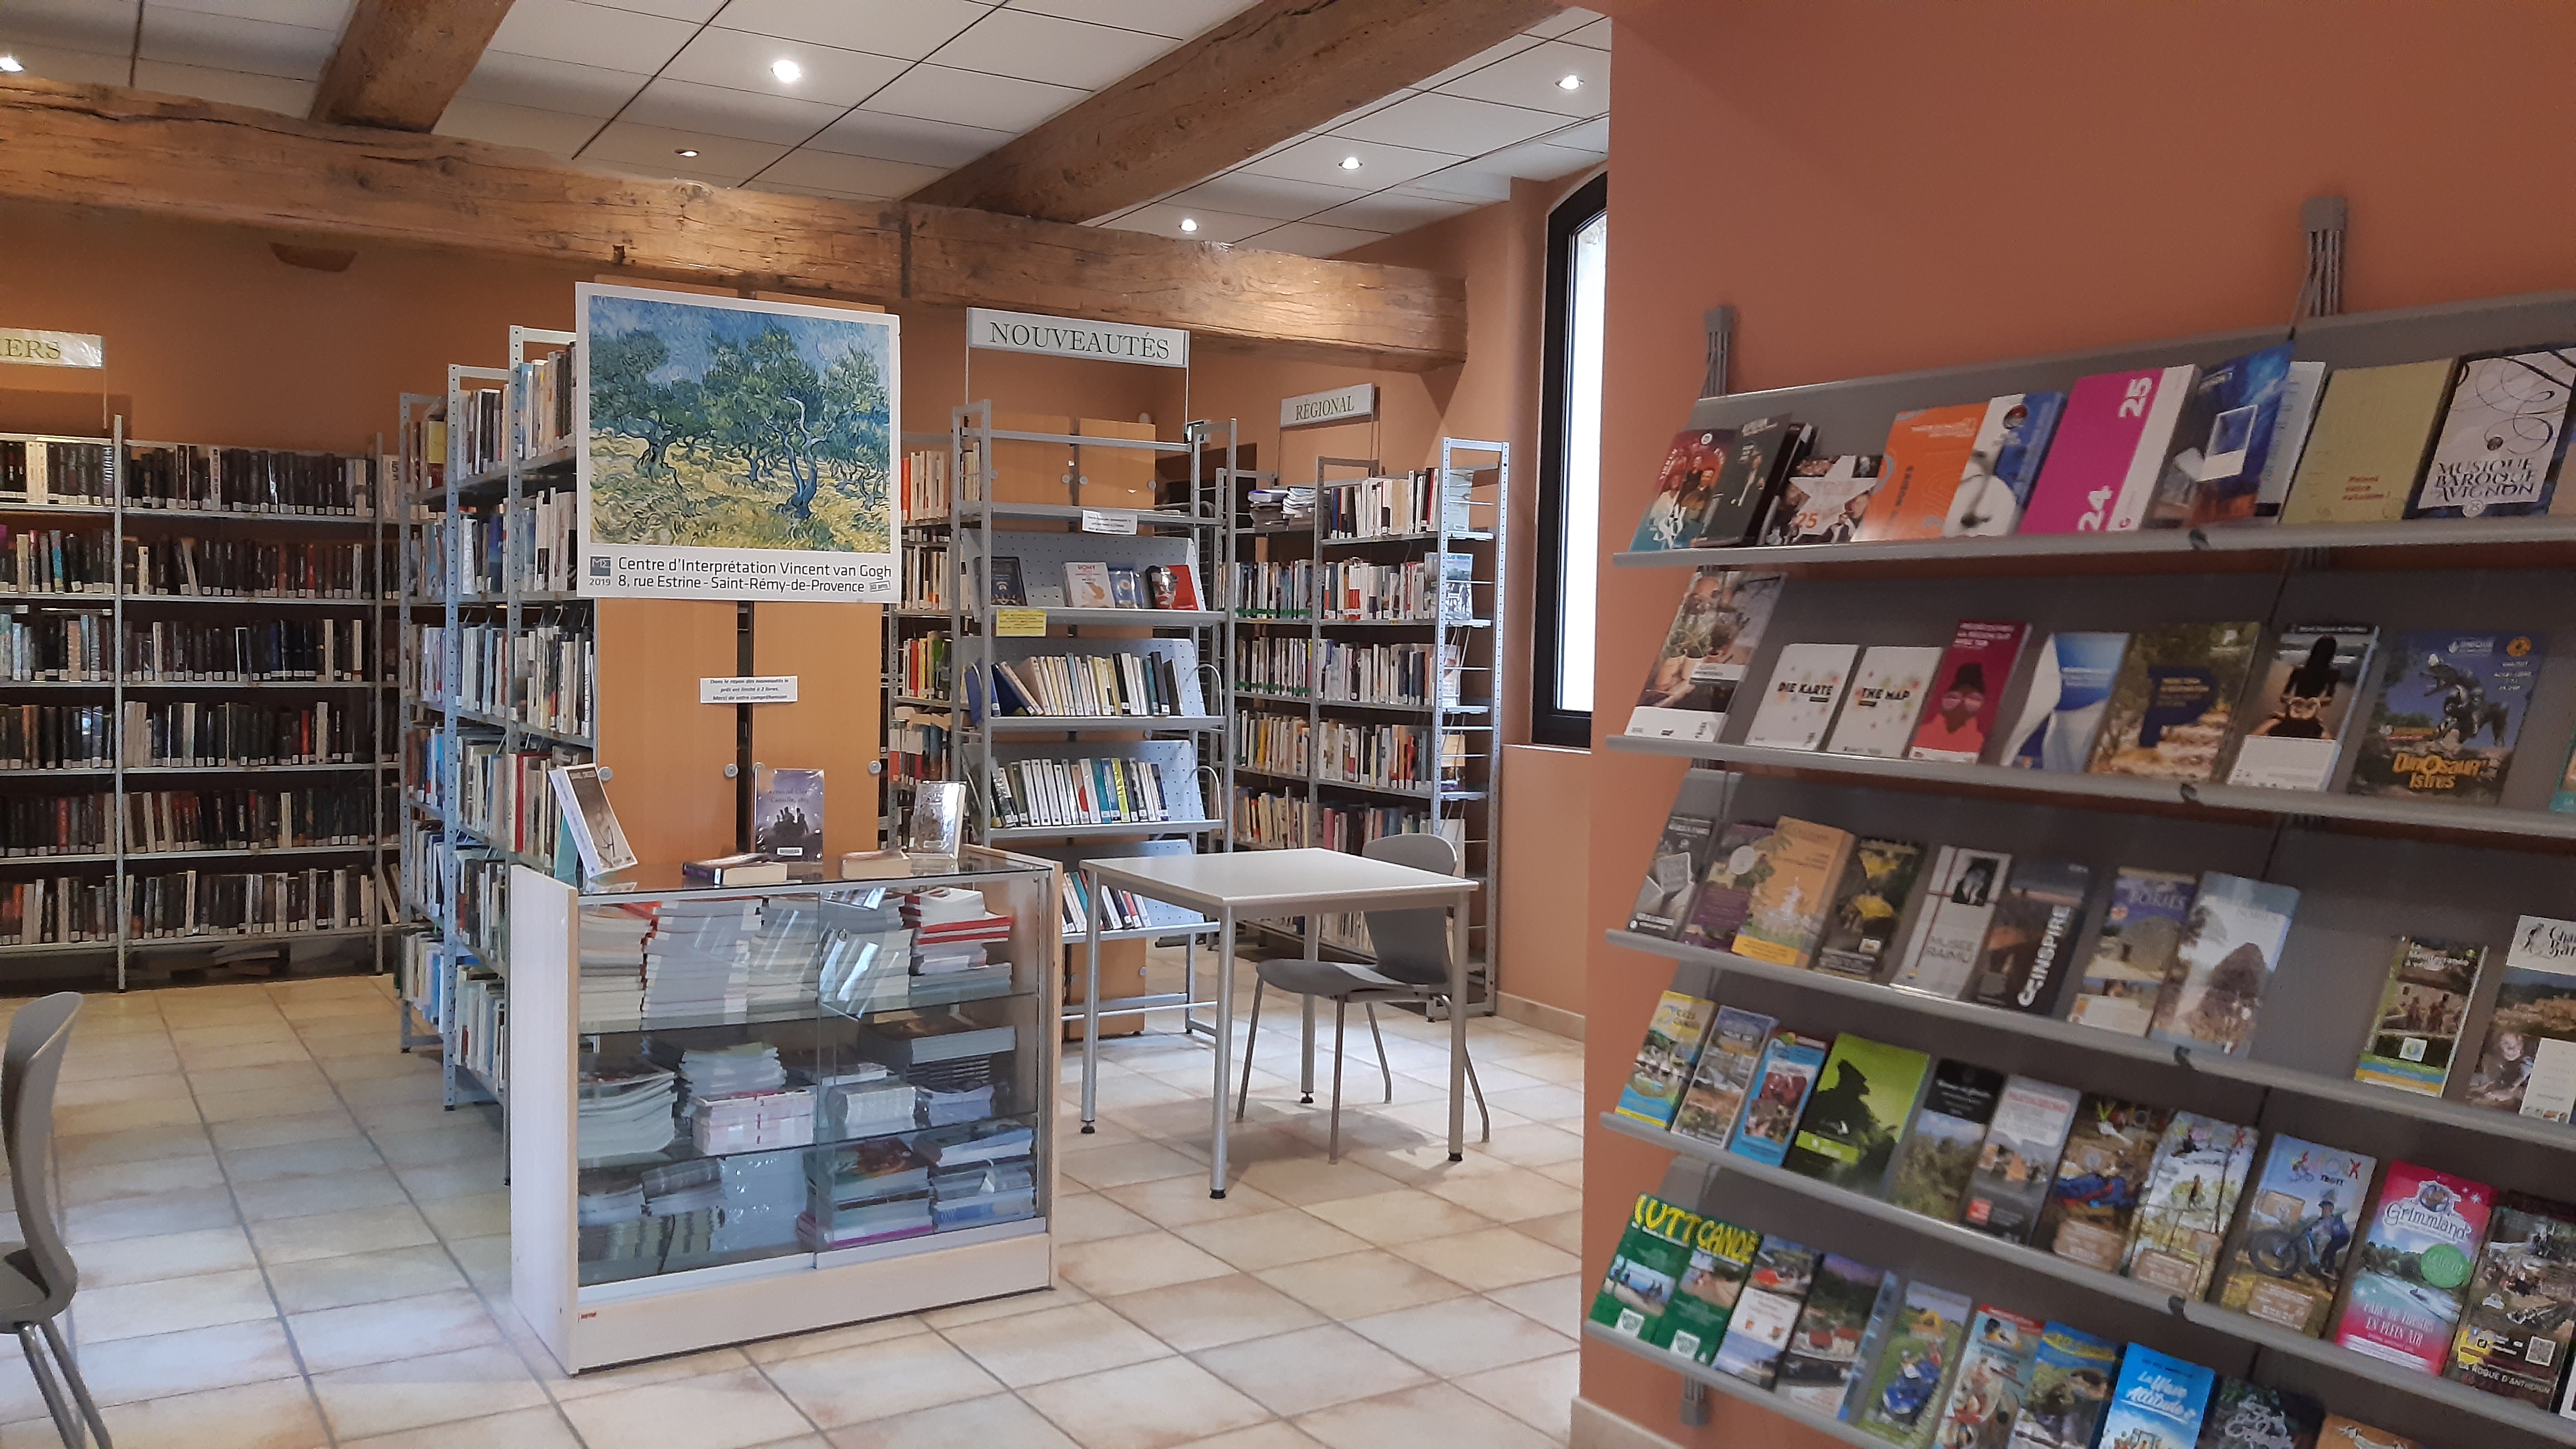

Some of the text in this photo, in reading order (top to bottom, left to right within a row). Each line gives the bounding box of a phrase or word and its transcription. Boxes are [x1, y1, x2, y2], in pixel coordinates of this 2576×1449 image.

[0, 338, 61, 359] ERS
[989, 321, 1169, 359] NOUVEAUTÉS
[1295, 395, 1355, 421] RÉGIONAL
[2118, 377, 2153, 418] 25
[2078, 485, 2113, 531] 24
[1798, 512, 1819, 529] 25
[618, 557, 892, 580] Centre d'Interprétation Vincent van Gogh
[618, 574, 630, 588] 8,
[634, 577, 654, 587] rue
[657, 575, 701, 588] Estrine
[711, 576, 865, 593] Saint-Rémy-de-Provence
[1778, 681, 1834, 696] DIE KARTE
[1862, 687, 1911, 700] THE MAP
[2383, 1202, 2470, 1242] Grimmland
